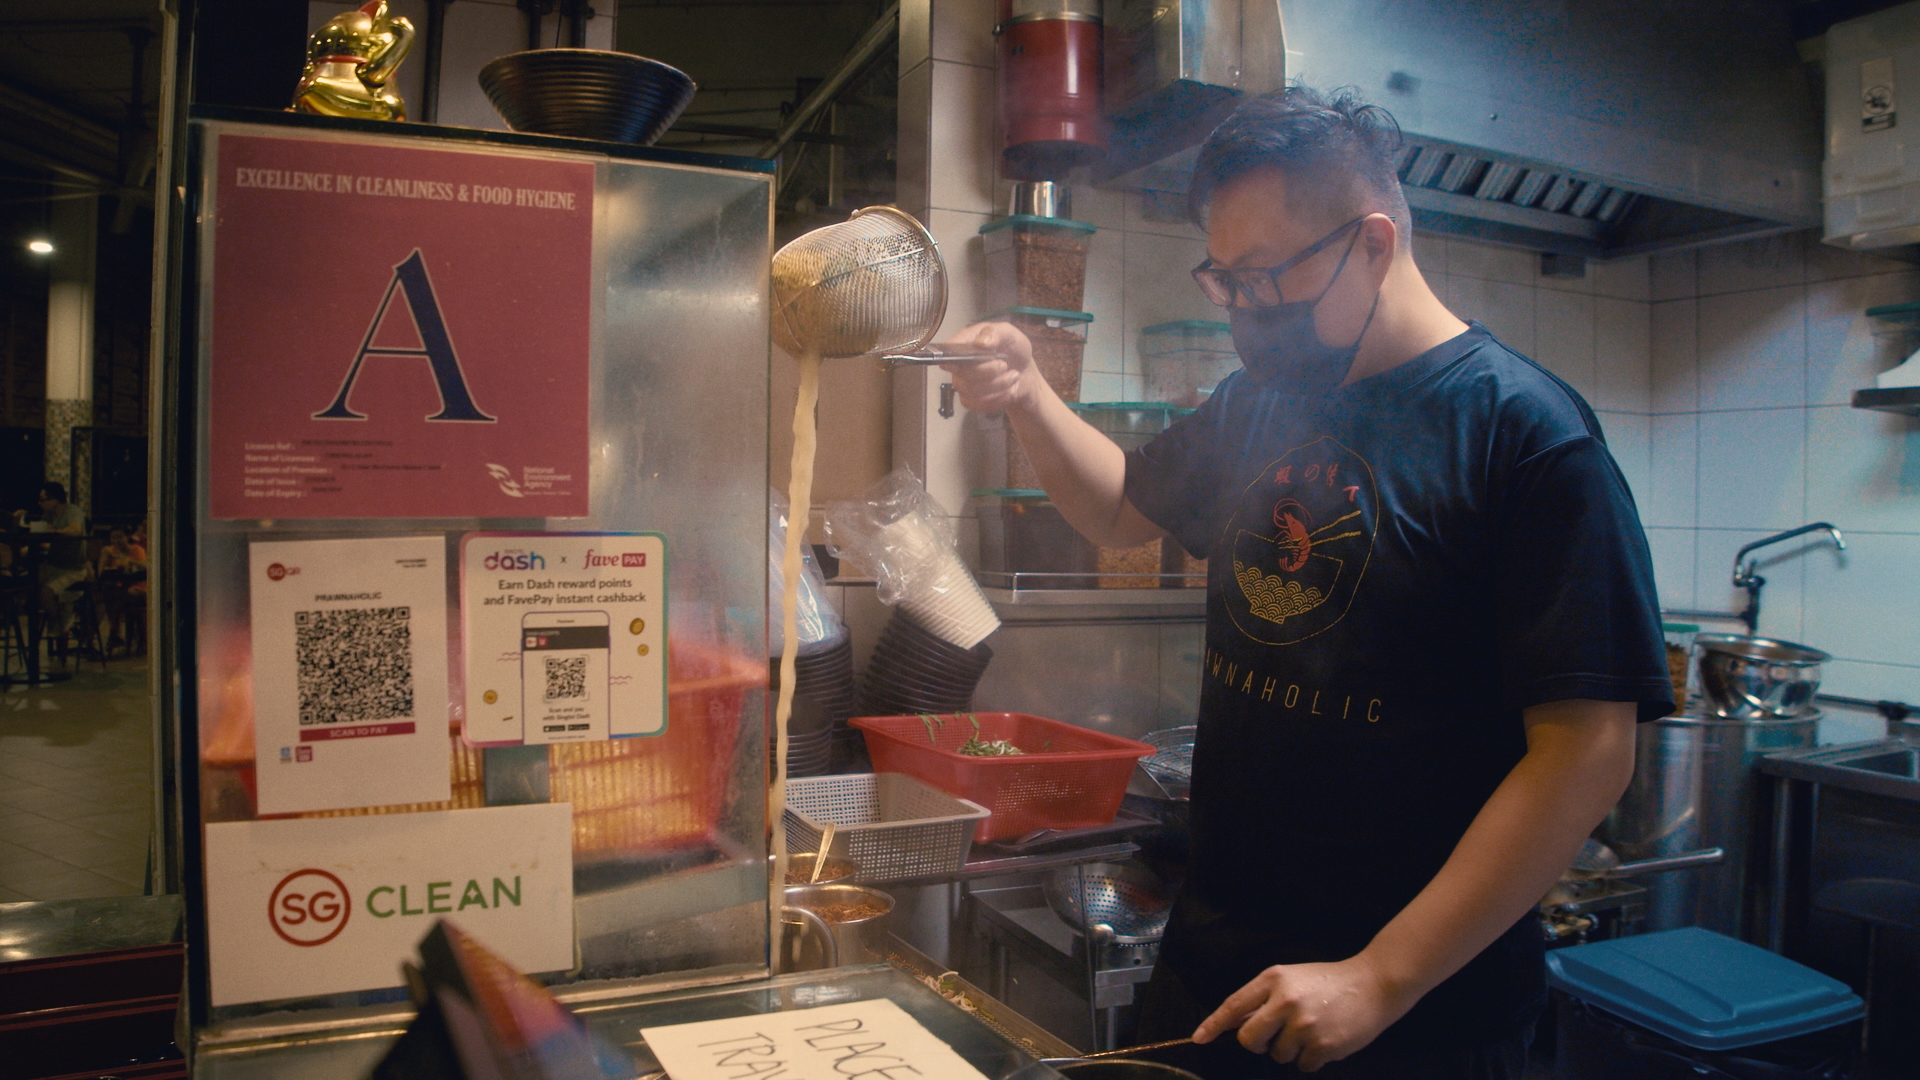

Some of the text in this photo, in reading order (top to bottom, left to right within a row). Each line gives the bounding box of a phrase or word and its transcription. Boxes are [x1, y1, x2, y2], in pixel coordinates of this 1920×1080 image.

[236, 167, 576, 211] EXCELLENCE IN CLEANLINESS & FOOD HYGIENE
[310, 247, 498, 424] A
[523, 466, 555, 474] National
[483, 551, 546, 571] dash
[582, 548, 620, 571] fave
[623, 555, 645, 566] PAY
[498, 577, 633, 591] Earn Dash reward points
[314, 591, 383, 602] PRAWNAHOLIC
[483, 591, 647, 607] and FavePay instant cashback
[329, 725, 389, 739] SCAN TO PAY
[280, 875, 522, 926] SG CLEAN
